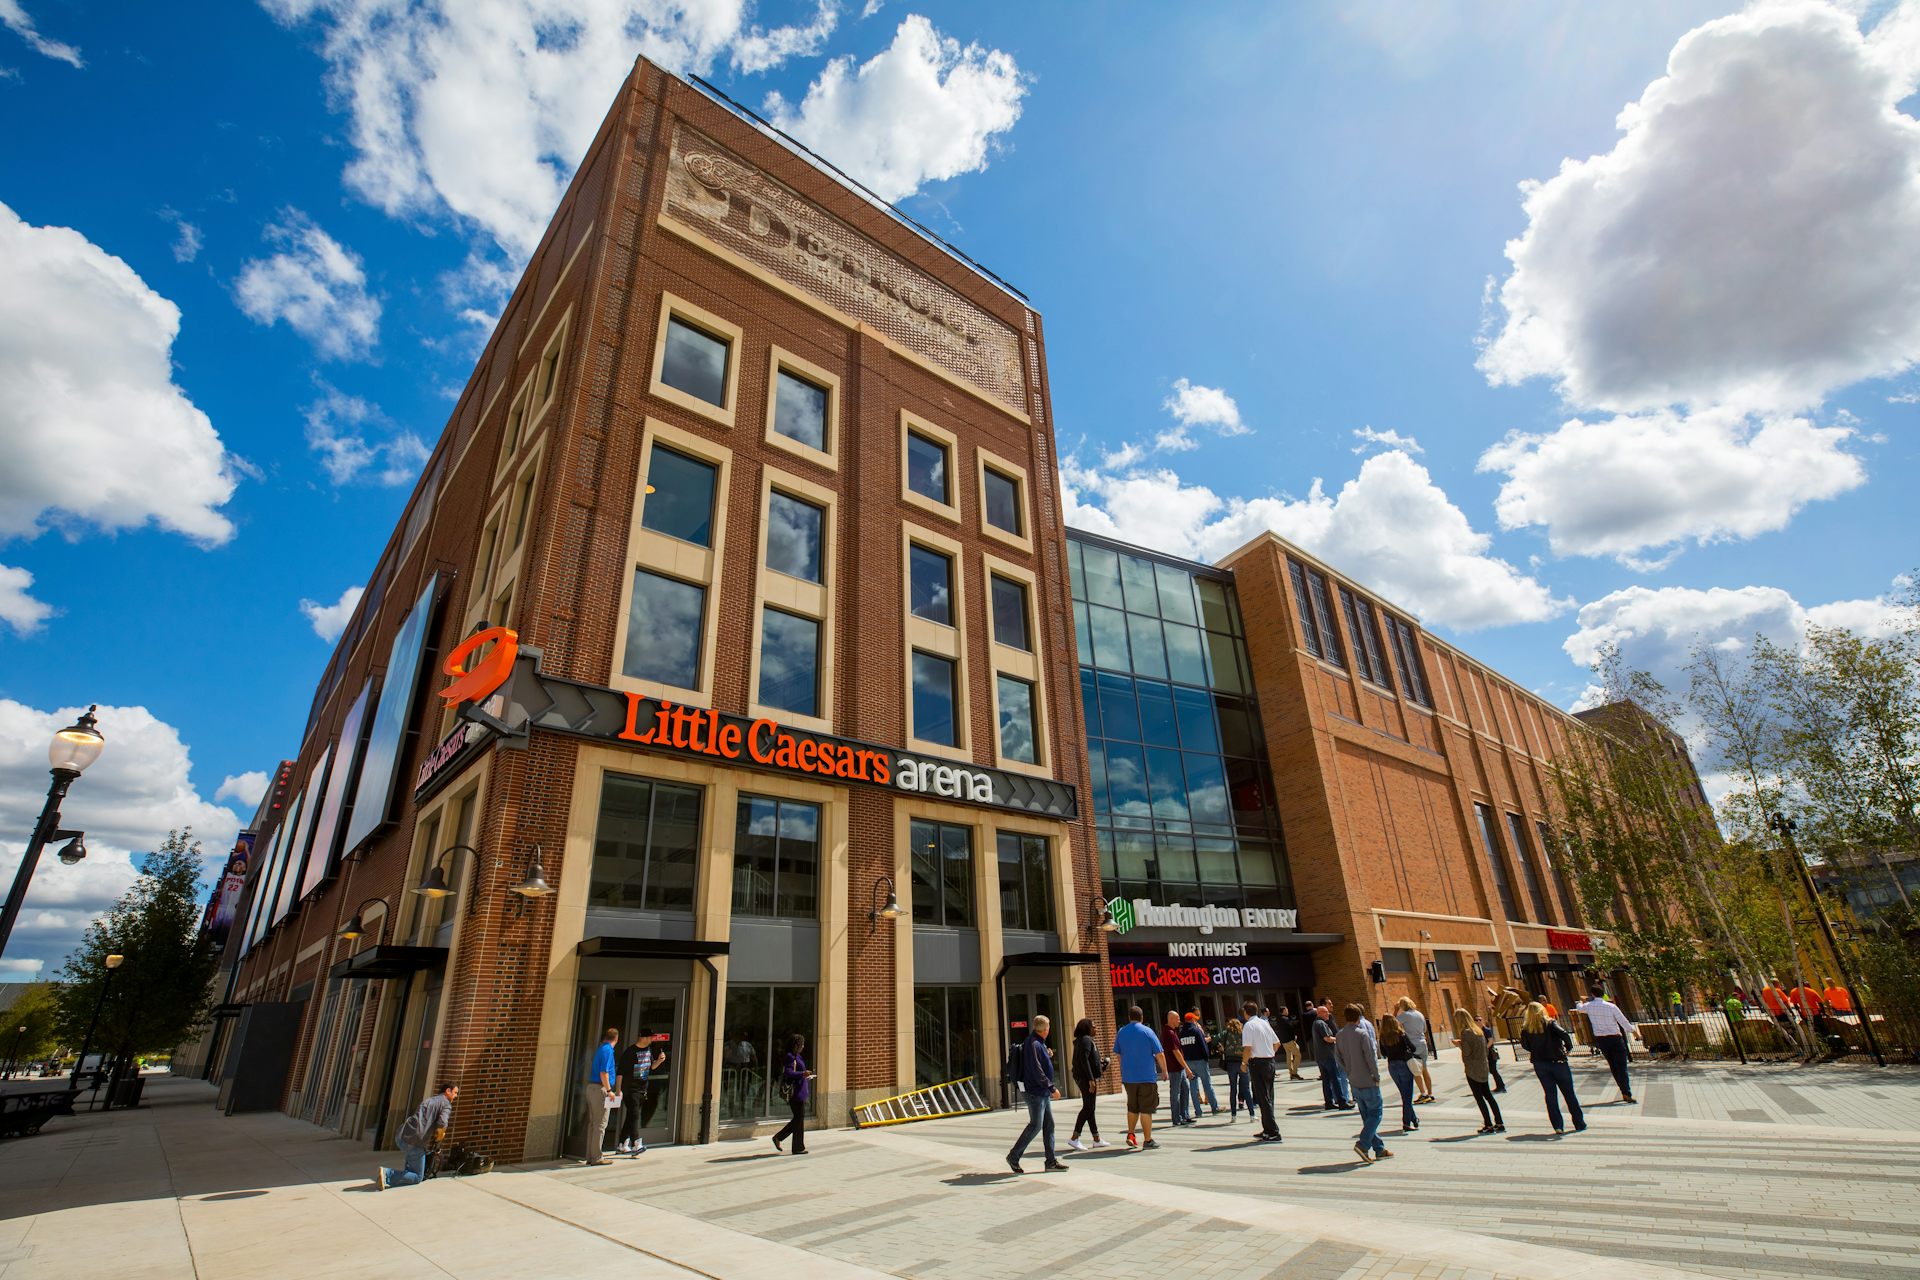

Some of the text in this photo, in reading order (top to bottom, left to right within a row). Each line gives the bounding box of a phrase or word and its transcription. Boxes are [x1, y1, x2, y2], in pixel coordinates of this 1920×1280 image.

[617, 691, 994, 804] Little Caesars arena
[1132, 898, 1298, 935] Huntington ENTRY
[1168, 942, 1248, 957] NORTHWEST
[1145, 961, 1210, 986] Caesars
[1212, 965, 1262, 985] arena
[1180, 1036, 1196, 1046] STAFF
